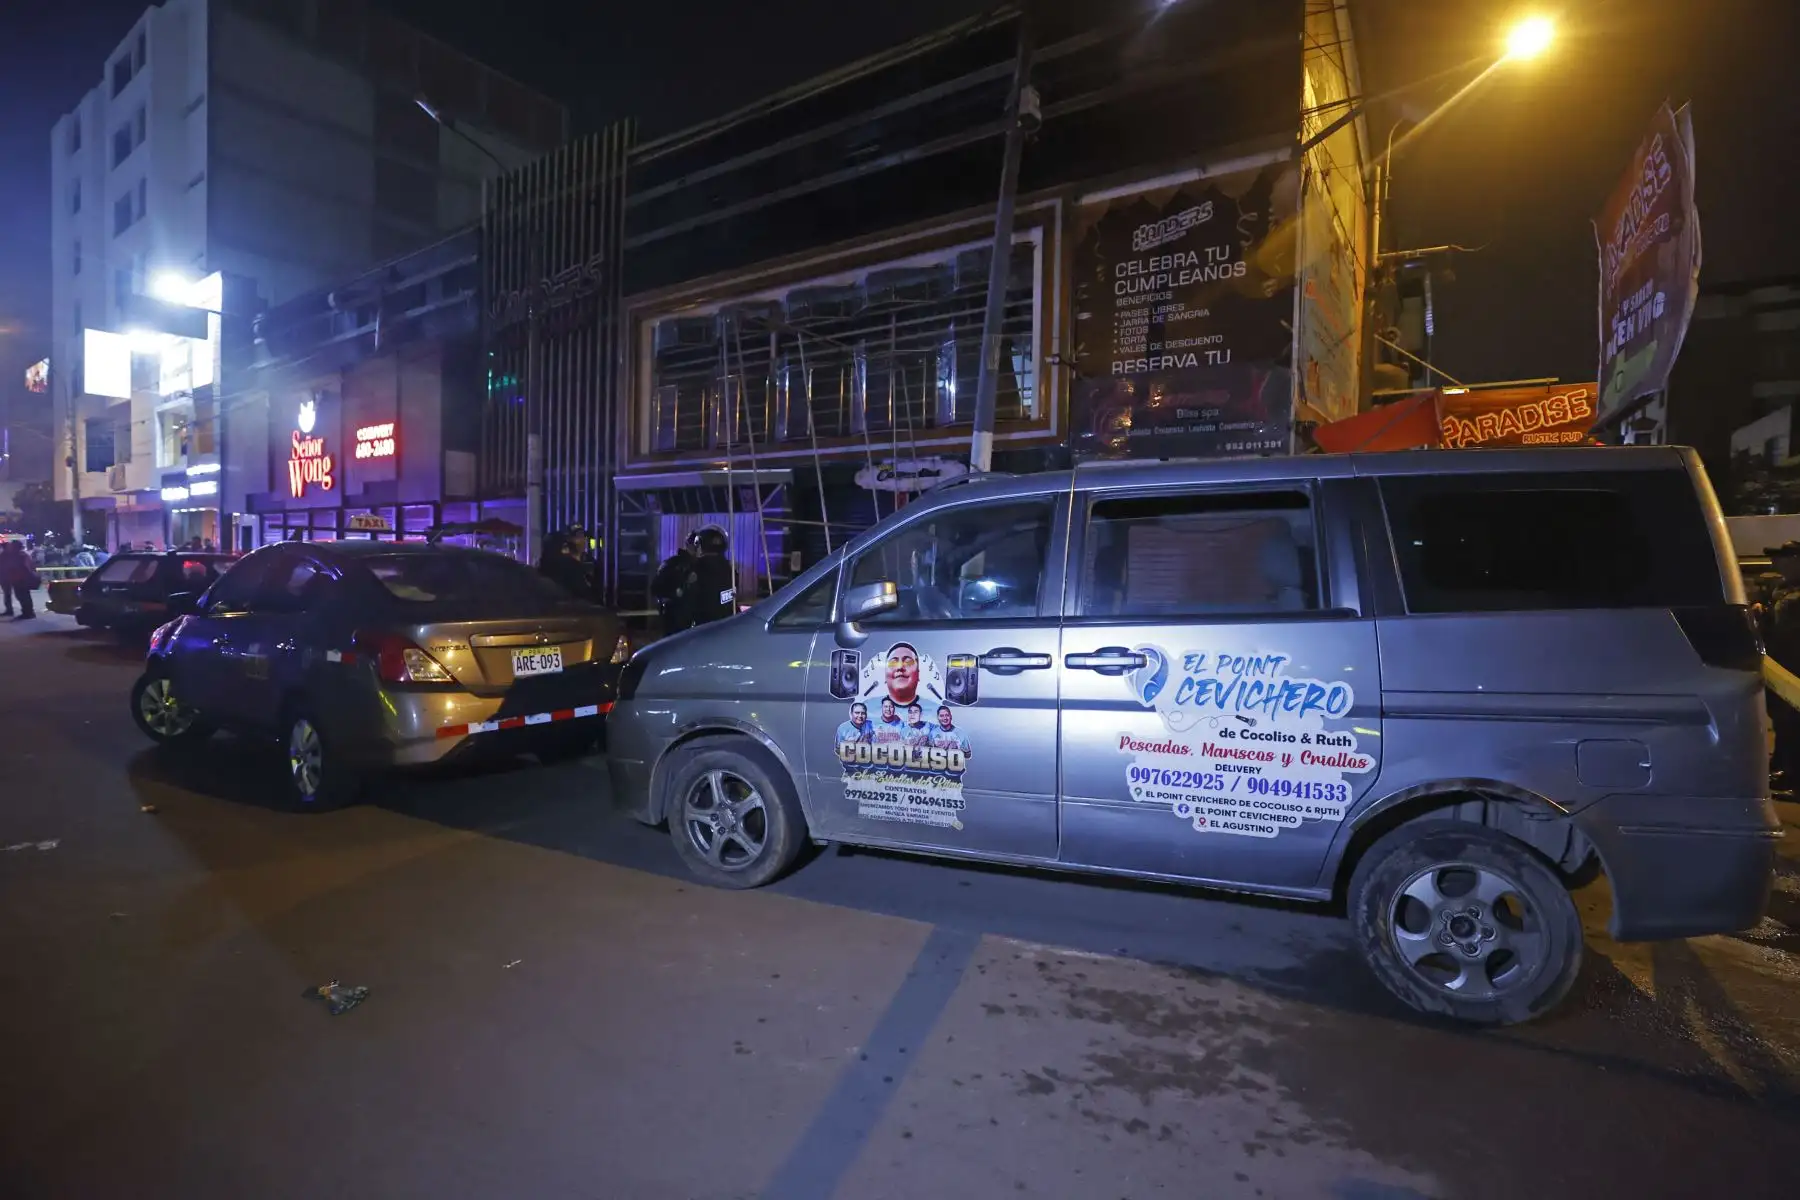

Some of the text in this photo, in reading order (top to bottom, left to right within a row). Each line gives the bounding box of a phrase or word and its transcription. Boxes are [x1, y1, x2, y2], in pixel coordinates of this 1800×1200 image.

[1115, 244, 1230, 278] CELEBRA TU
[1114, 261, 1246, 295] CUMPLEAÑOS
[1116, 290, 1173, 307] BENEFICIOS
[1119, 308, 1210, 328] JARRA DE SANGRIA
[1120, 303, 1185, 319] PASES LIBRES
[1119, 335, 1147, 346] TORTA
[1120, 326, 1149, 337] FOTOS
[1119, 334, 1223, 354] VALES DE DESCUENTO
[1111, 348, 1231, 375] RESERVA TU
[1441, 388, 1591, 449] PARADISE
[292, 430, 323, 459] Señor
[1523, 432, 1559, 444] RUSTIC
[288, 456, 332, 498] Wong
[355, 517, 384, 528] TAXI
[516, 653, 560, 672] ARE-093
[1183, 653, 1287, 678] EL POINT
[1175, 673, 1348, 722] CEVICHERO
[1219, 727, 1352, 747] de Cocoliso & Ruth
[840, 741, 965, 771] COCOLISO
[1201, 742, 1276, 761] Mariscos
[1281, 752, 1294, 767] y
[1300, 750, 1369, 769] Criollos
[1215, 763, 1262, 774] DELIVERY
[884, 785, 927, 794] CONTRATOS
[1130, 766, 1347, 802] 997622925 / 904941533
[844, 789, 965, 809] 997622925 / 904941533
[1145, 790, 1155, 798] EL
[1157, 791, 1183, 801] POINT
[1185, 794, 1237, 806] CEVICHERO
[1253, 801, 1303, 812] COCOLISO
[1314, 807, 1340, 816] RUTH
[1195, 807, 1297, 824] EL POINT CEVICHERO
[1210, 820, 1274, 834] EL AGUSTINO
